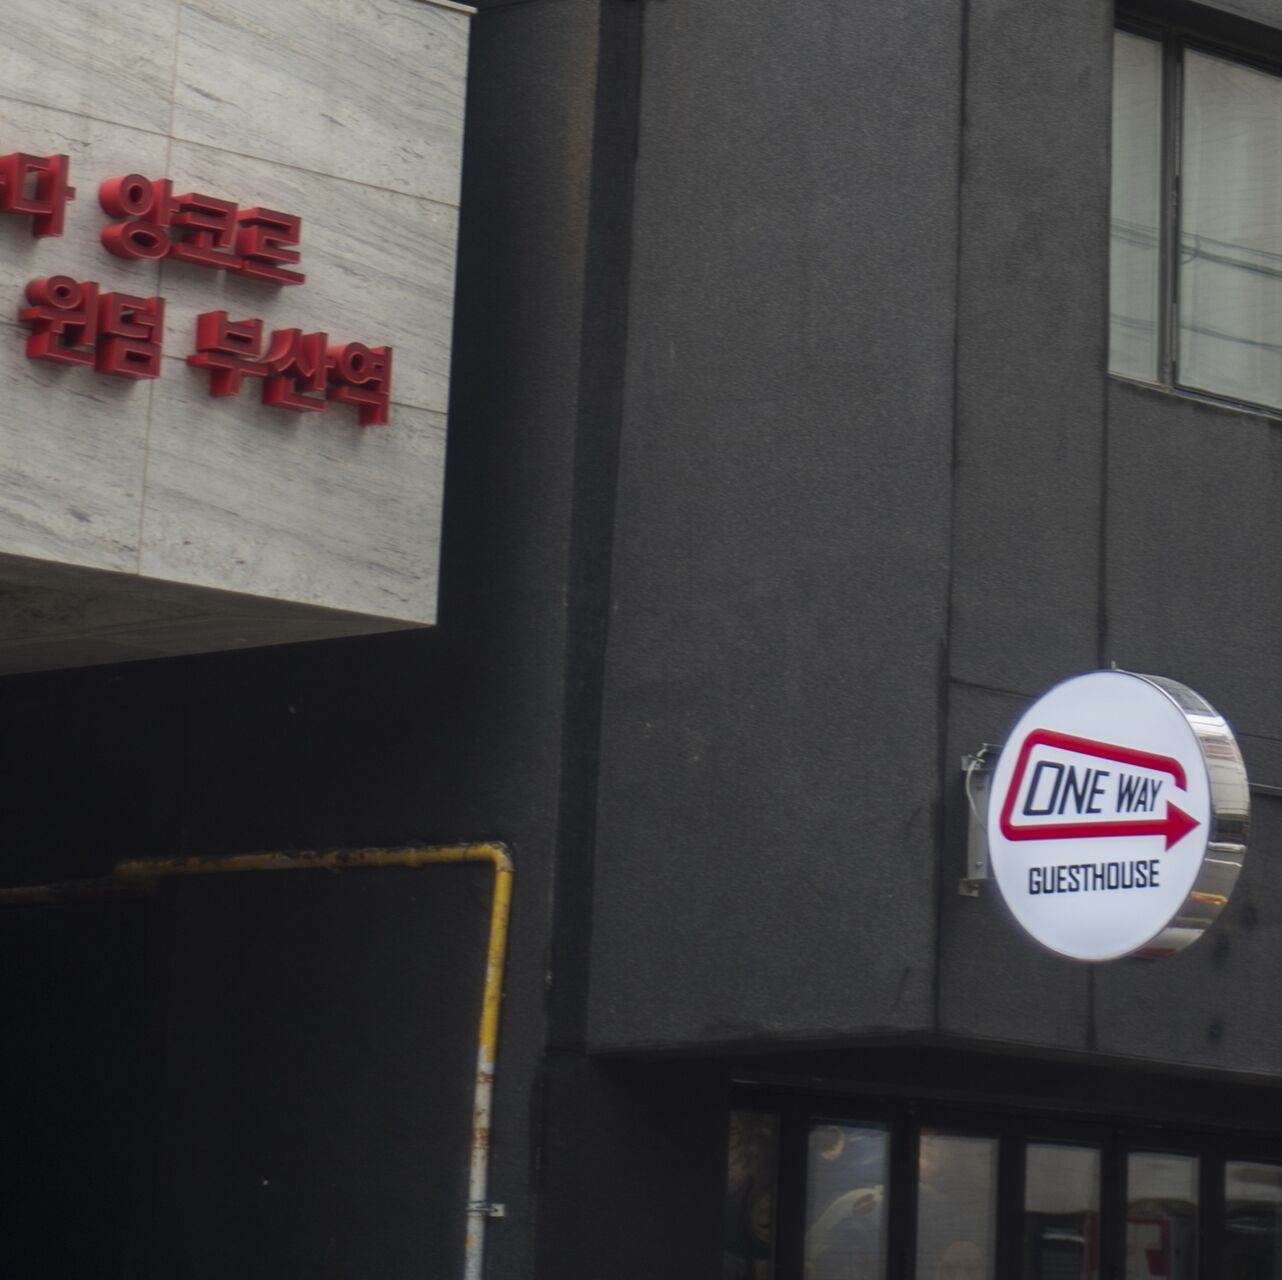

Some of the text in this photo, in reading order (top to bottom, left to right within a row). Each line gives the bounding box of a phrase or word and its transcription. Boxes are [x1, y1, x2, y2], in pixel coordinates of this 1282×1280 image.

[98, 172, 306, 286] 앙코르
[18, 274, 393, 427] 윈덤 부산역
[1022, 759, 1164, 816] ONE WAY
[1028, 858, 1160, 895] GUESTHOUSE
